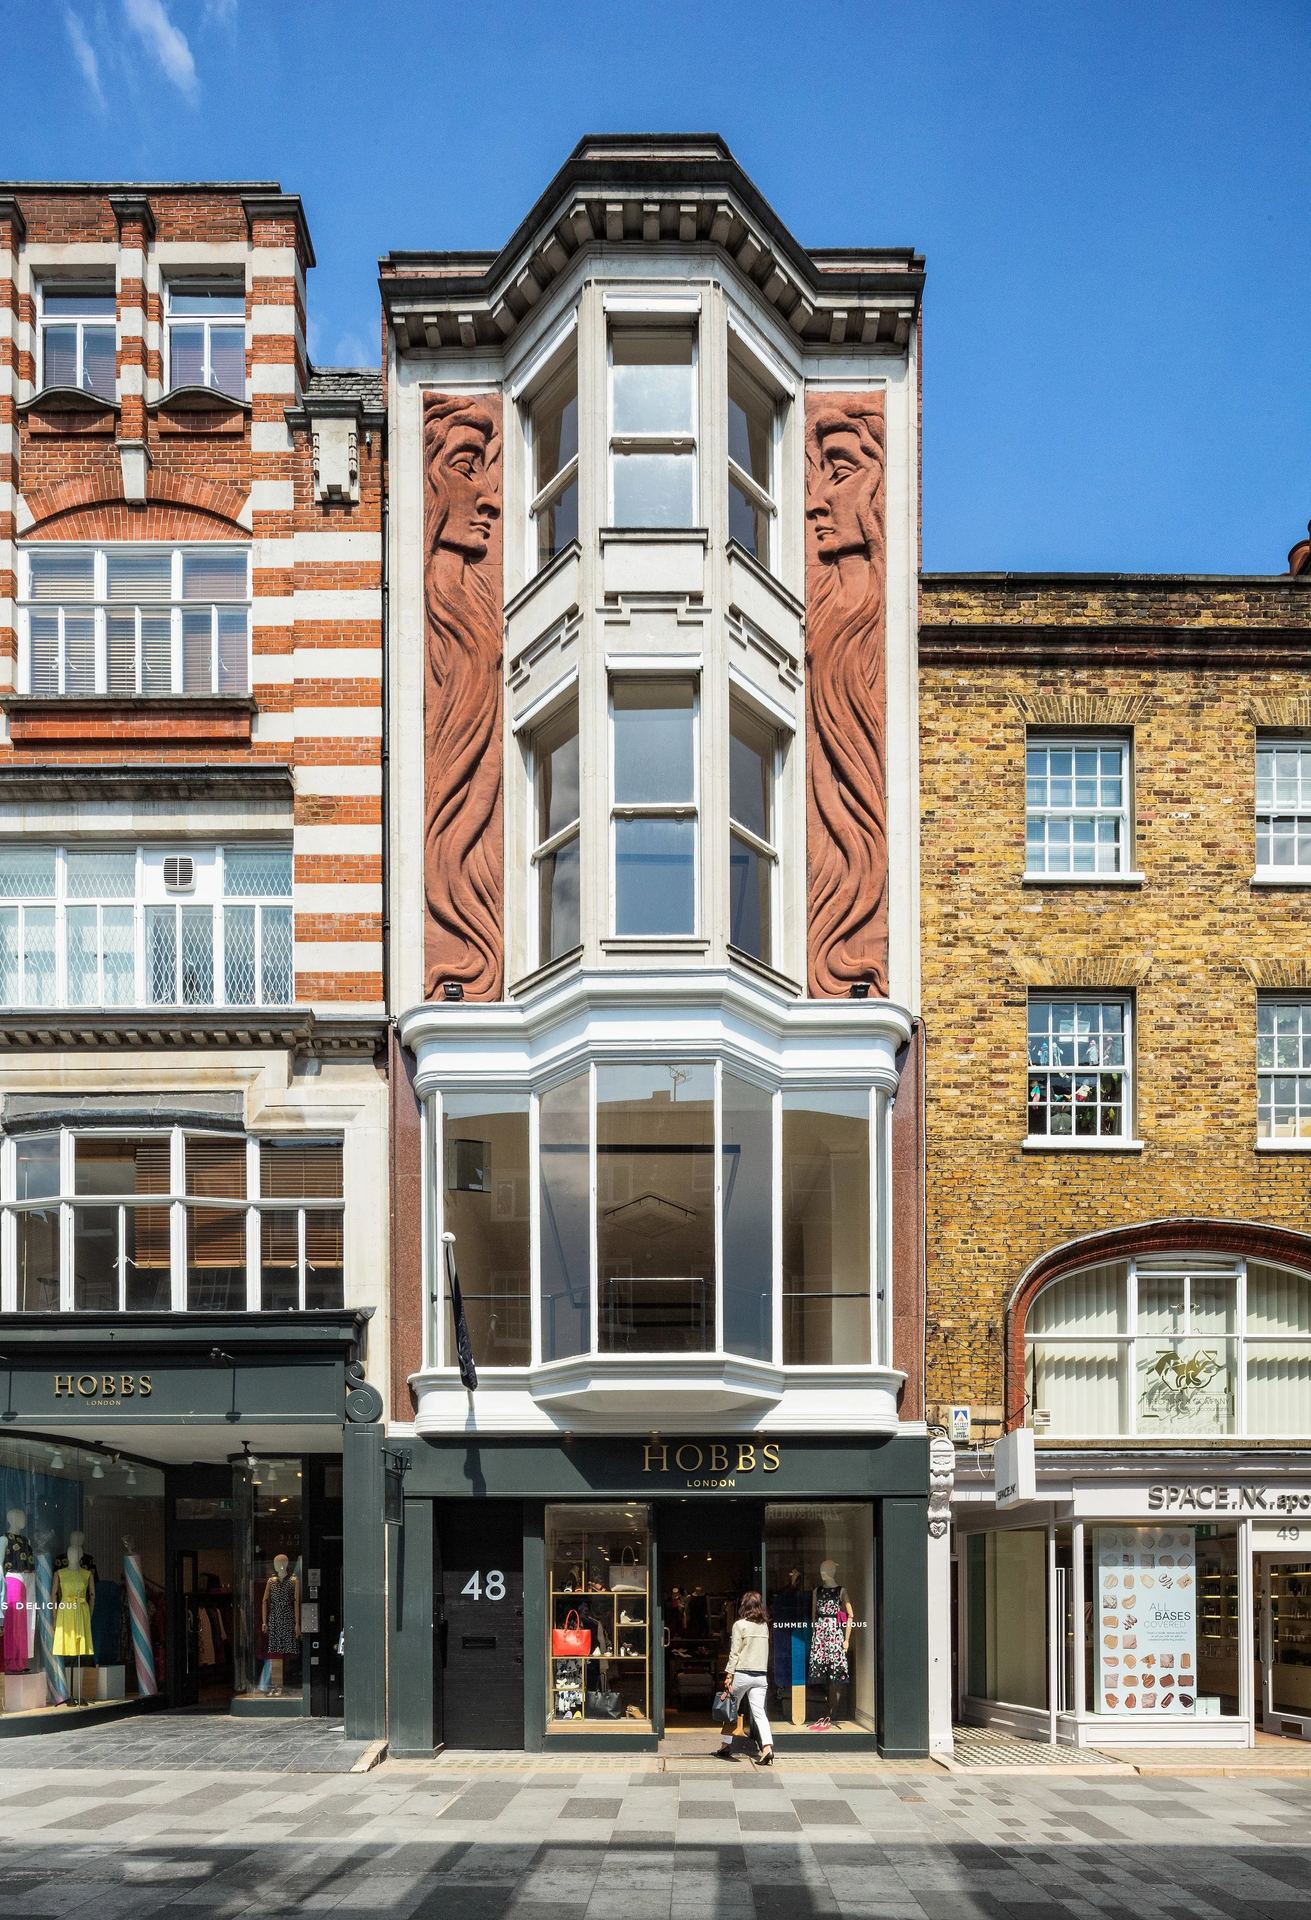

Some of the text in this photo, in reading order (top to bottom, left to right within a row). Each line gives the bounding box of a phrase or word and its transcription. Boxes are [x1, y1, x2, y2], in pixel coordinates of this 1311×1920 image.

[53, 1375, 153, 1397] HOBBS
[641, 1443, 781, 1472] HOBBS
[686, 1479, 736, 1487] LONDON
[1276, 1526, 1300, 1541] 49
[460, 1570, 506, 1601] 48
[16, 1602, 77, 1610] DELICIOUS
[1150, 1602, 1170, 1611] ALL
[1155, 1611, 1191, 1621] BASES
[1144, 1620, 1186, 1629] COVERED
